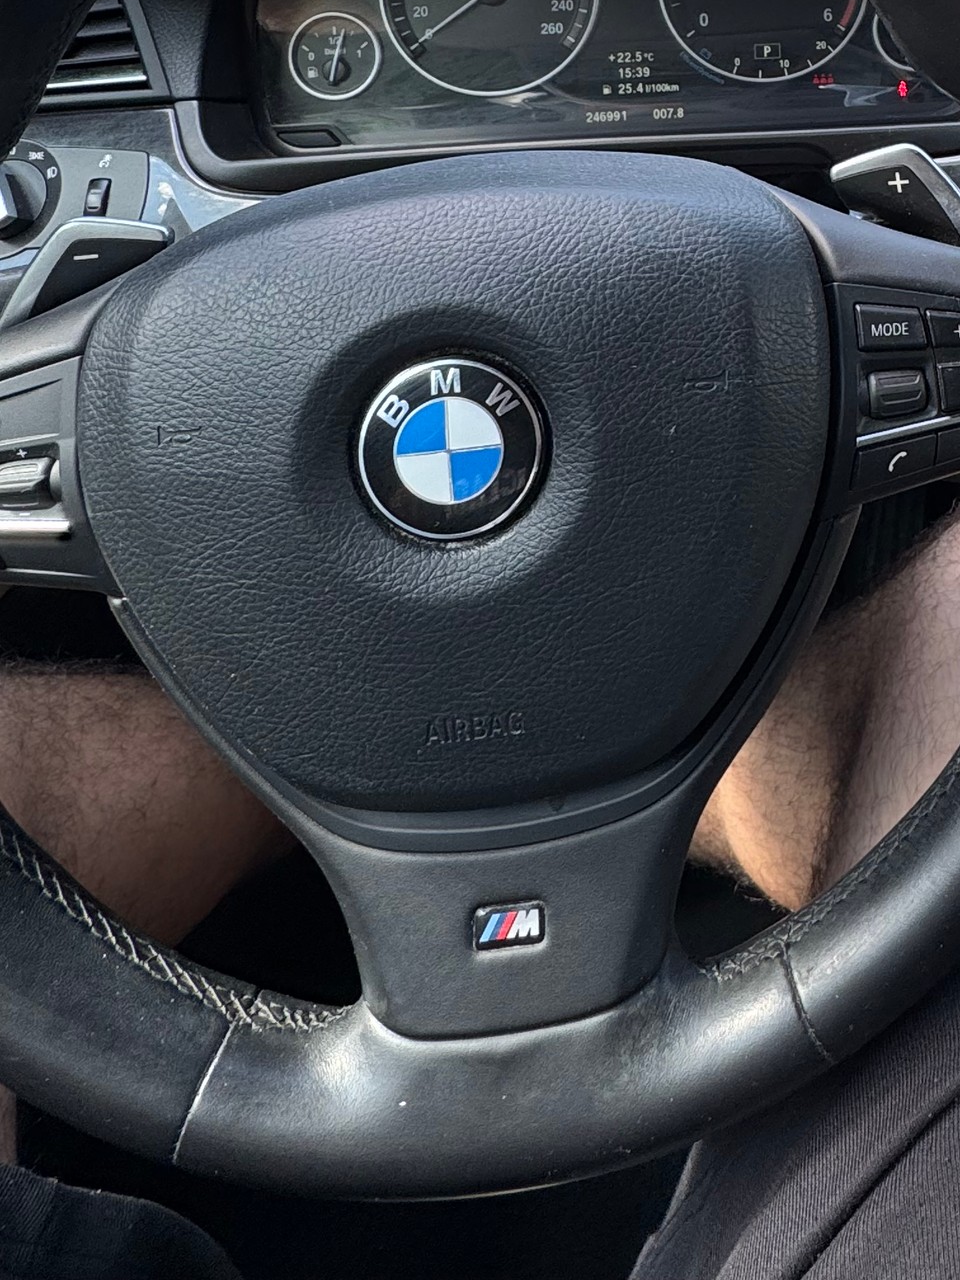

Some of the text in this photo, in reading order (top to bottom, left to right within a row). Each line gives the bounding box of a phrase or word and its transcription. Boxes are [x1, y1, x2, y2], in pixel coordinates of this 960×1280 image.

[412, 5, 429, 18] 20
[551, 0, 574, 12] 240
[699, 12, 709, 27] 0
[823, 8, 833, 22] 6
[540, 22, 564, 35] 260
[763, 45, 772, 58] P
[815, 41, 827, 50] 20
[308, 51, 315, 61] 0
[356, 49, 362, 59] 1
[734, 57, 741, 67] 0
[779, 59, 790, 68] 10
[618, 66, 651, 79] 15:39
[618, 82, 644, 95] 25.4
[585, 107, 685, 124] 246991 007.8
[871, 322, 909, 337] MODE
[376, 367, 521, 429] BMW
[425, 711, 526, 746] AIRBAG
